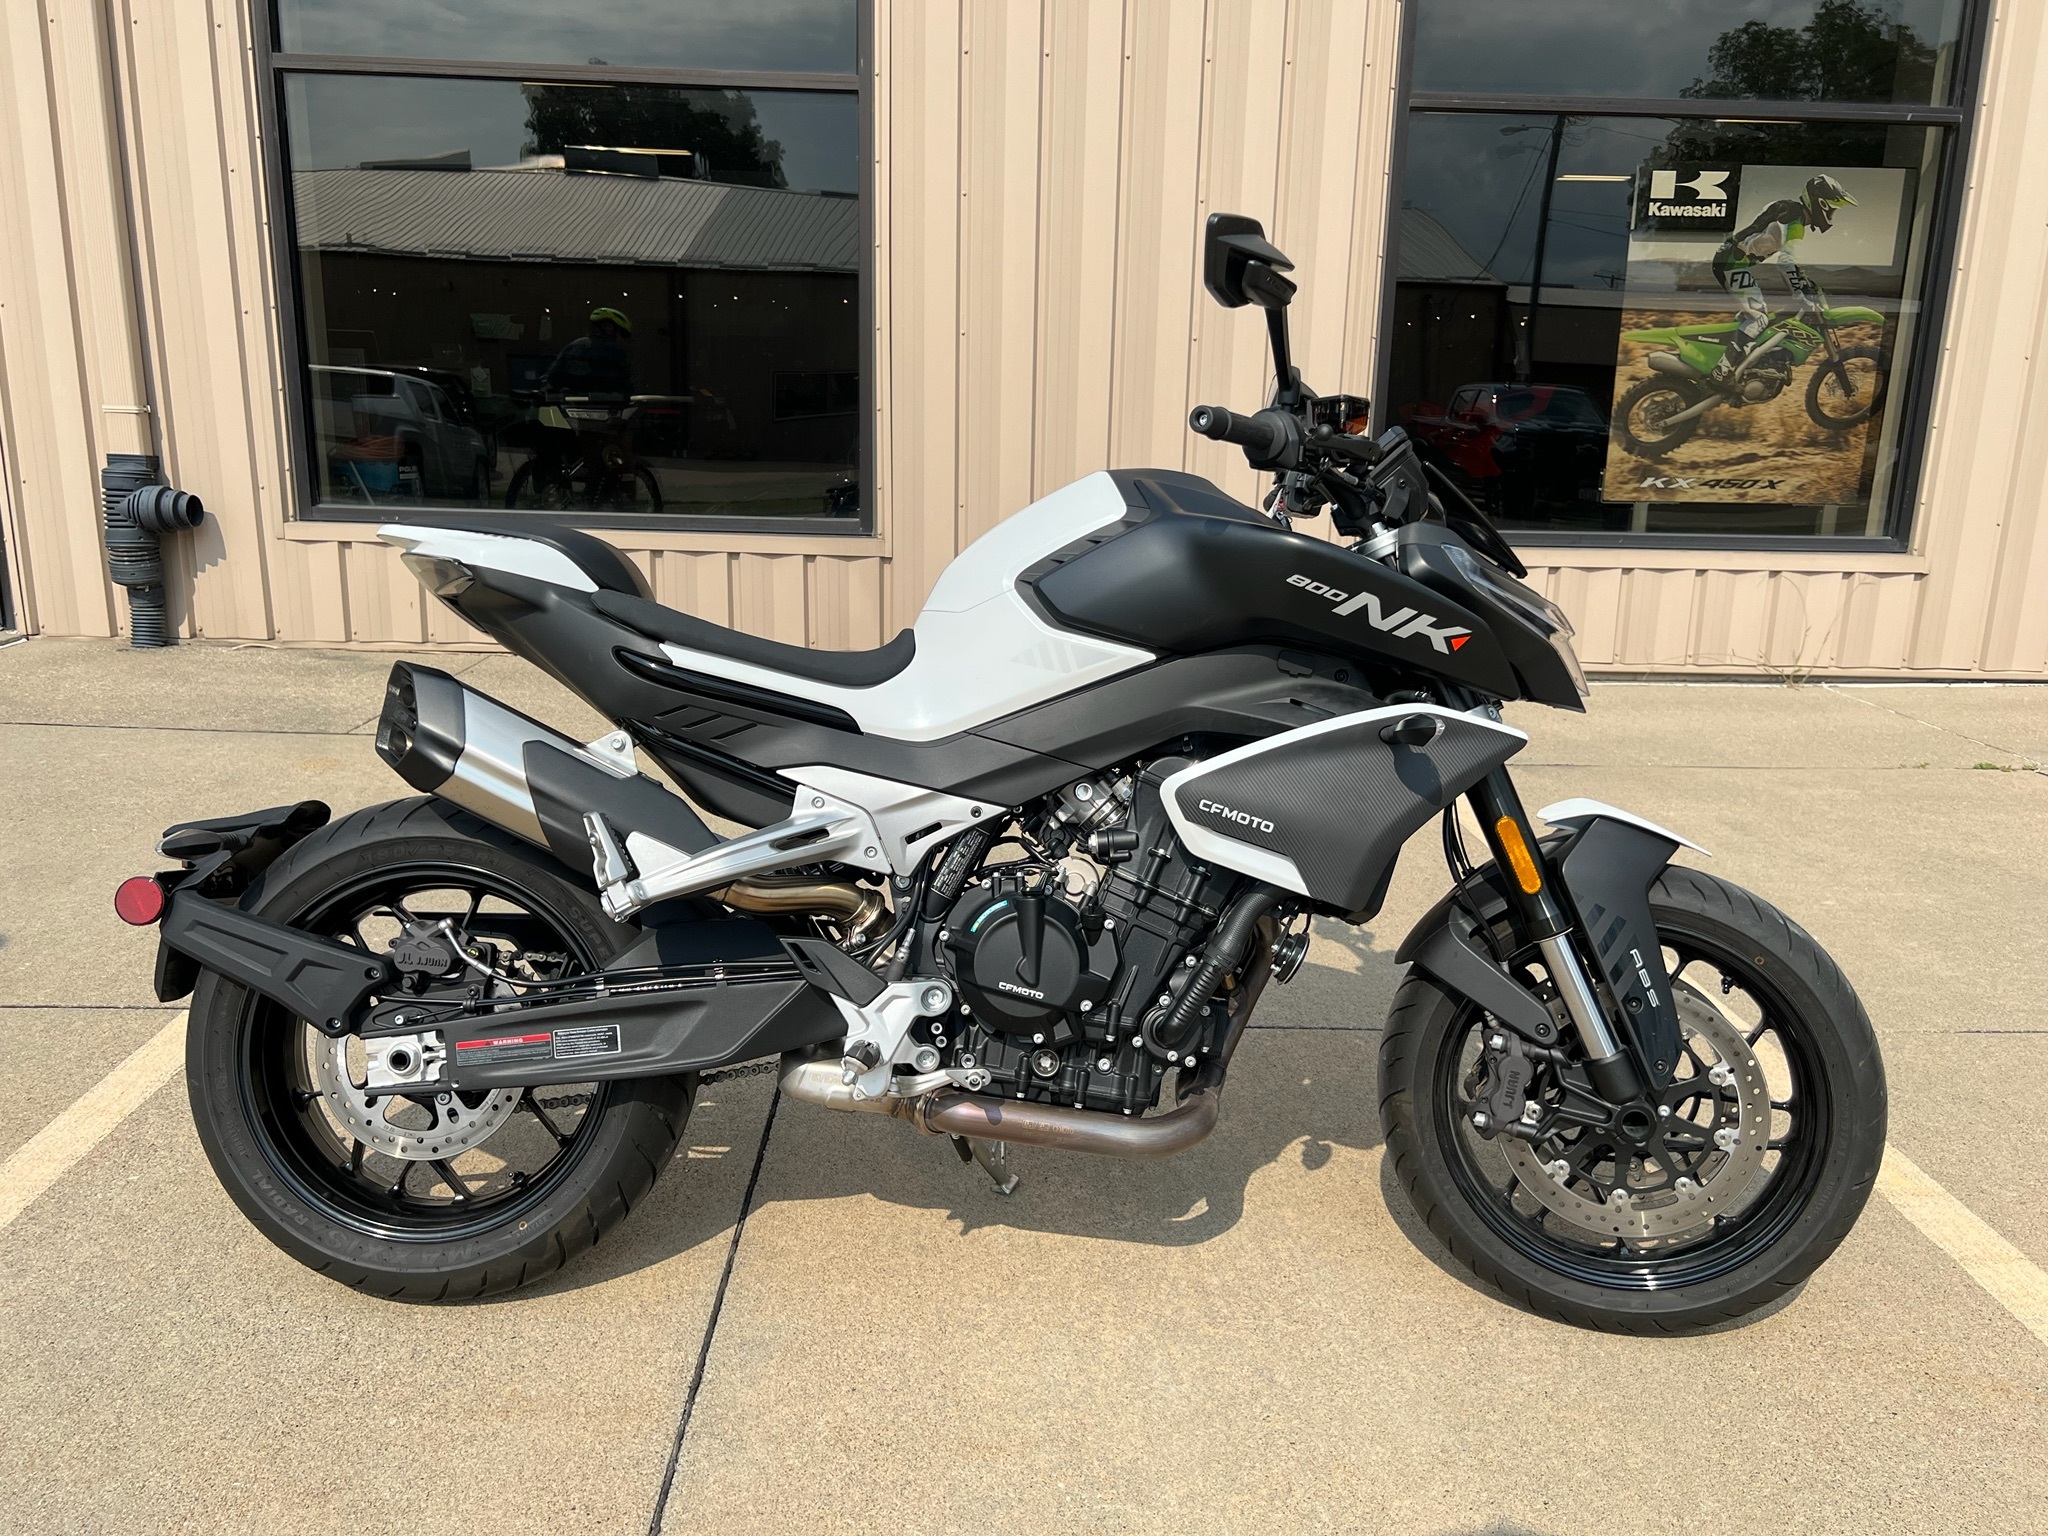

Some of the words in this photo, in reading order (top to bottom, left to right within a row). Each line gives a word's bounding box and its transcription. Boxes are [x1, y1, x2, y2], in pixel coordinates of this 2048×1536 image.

[1648, 202, 1726, 218] Kawasaki
[1640, 476, 1696, 489] KX
[1699, 478, 1787, 490] 450X
[1286, 574, 1349, 602] 800
[1331, 591, 1473, 655] NK
[1198, 799, 1275, 834] CFMOTO
[998, 981, 1044, 1000] CFMOTO
[1629, 948, 1661, 1008] ABS
[492, 1037, 524, 1046] WARNING
[252, 1167, 310, 1226] RADIAL
[325, 1228, 475, 1267] MAXXIS
